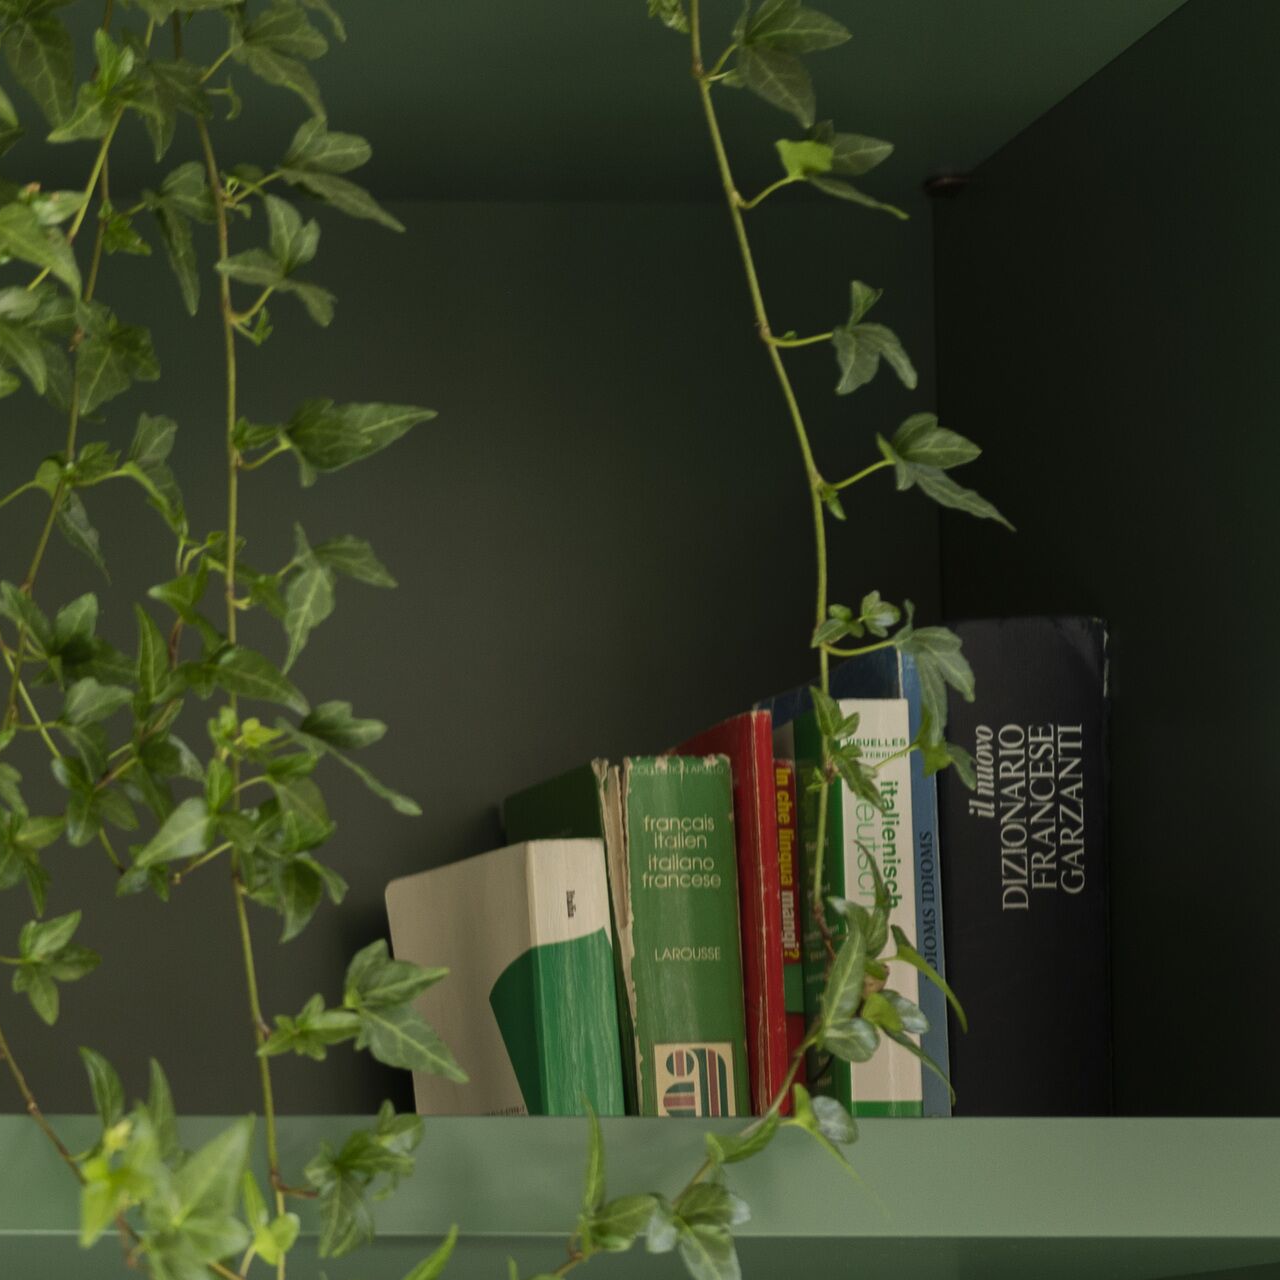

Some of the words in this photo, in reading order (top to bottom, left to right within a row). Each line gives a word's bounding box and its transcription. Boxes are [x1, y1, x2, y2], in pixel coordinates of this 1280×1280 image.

[975, 724, 996, 796] nuovo
[968, 799, 996, 819] il
[1028, 723, 1058, 889] FRANCESE
[1057, 723, 1086, 894] GARZANTI
[644, 814, 715, 833] français
[998, 723, 1030, 911] DIZIONARIO
[654, 832, 708, 849] italien
[648, 854, 715, 872] italiano
[919, 830, 935, 905] IDIOMS
[643, 873, 722, 889] francese
[655, 947, 721, 962] LAROUSSE
